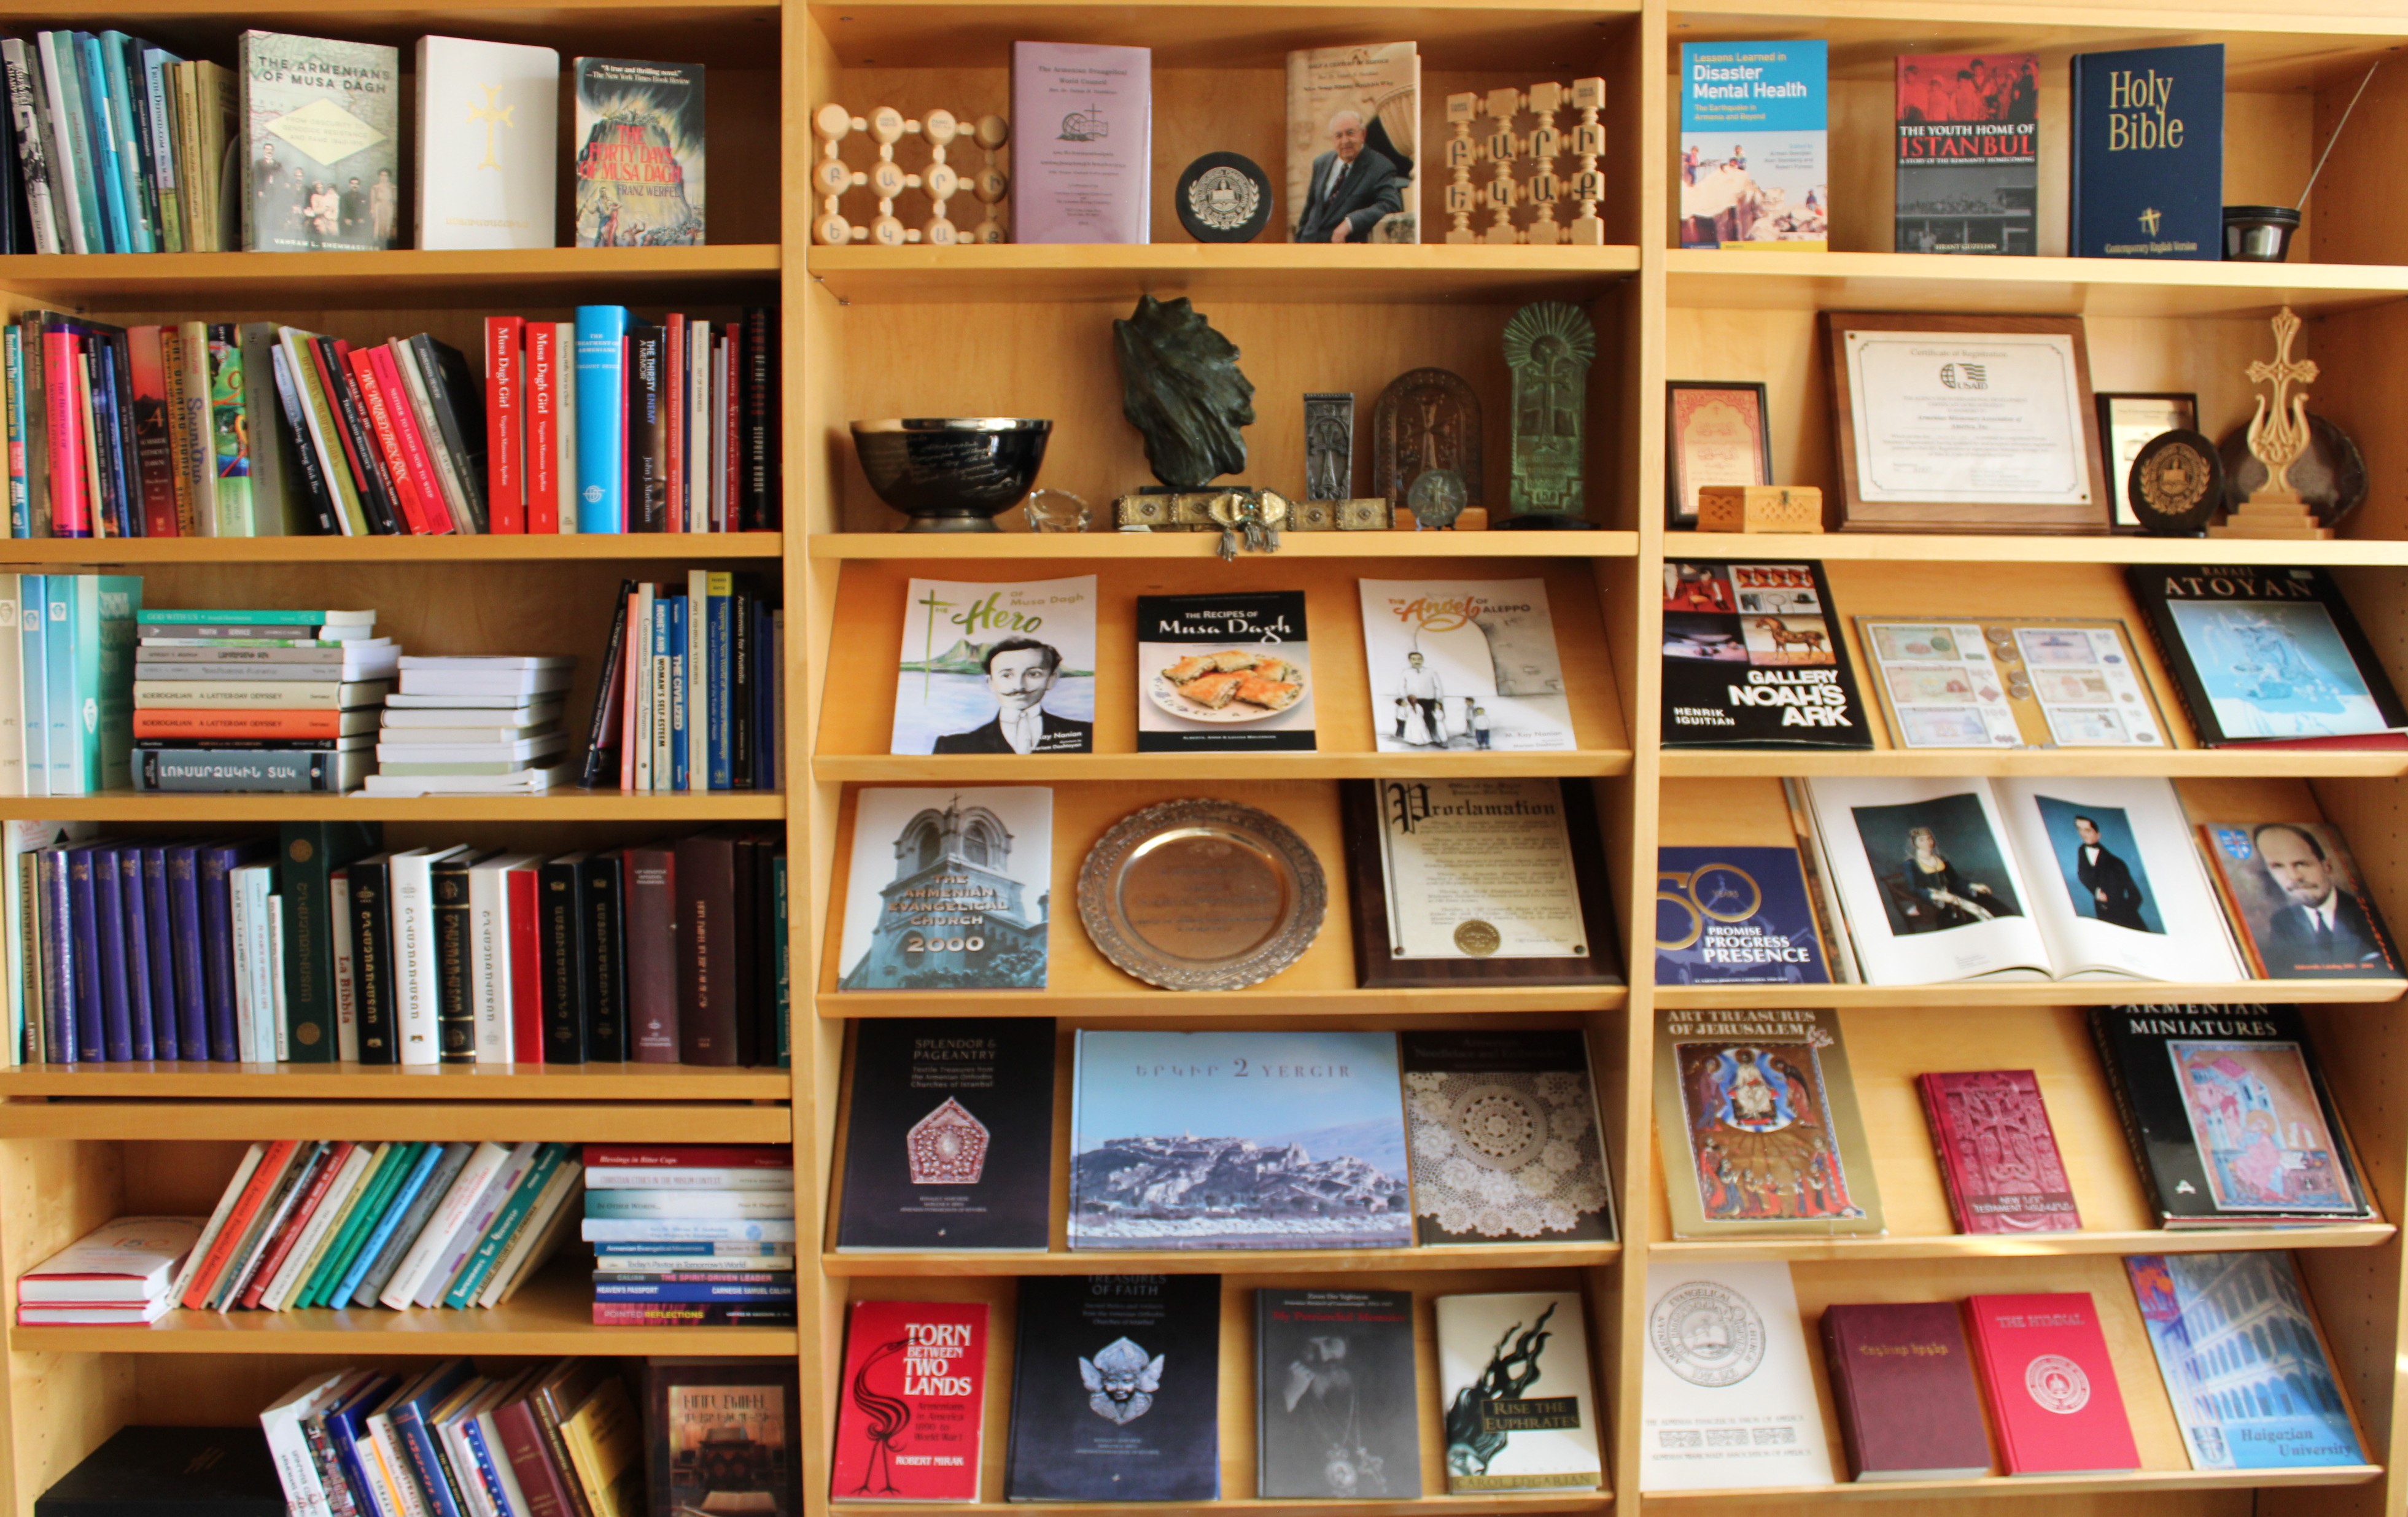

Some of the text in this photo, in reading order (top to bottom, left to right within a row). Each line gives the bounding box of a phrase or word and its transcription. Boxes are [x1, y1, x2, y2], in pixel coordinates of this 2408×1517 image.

[1694, 53, 1733, 62] Lessons
[1736, 52, 1775, 61] Learned
[258, 56, 390, 80] THE ARMENIANS
[1693, 64, 1763, 80] Disaster
[264, 71, 386, 93] OF MUSA DAGH
[1693, 81, 1807, 99] Mental Health
[2108, 69, 2174, 117] Holy
[1709, 104, 1749, 112] Earthquake
[1741, 112, 1766, 121] Beyond
[616, 125, 645, 144] THE
[1900, 123, 2035, 137] THE YOUTH HOME OF
[2108, 105, 2183, 151] Bible
[589, 142, 674, 164] FORTY DAYS
[1900, 135, 2035, 157] ISTANBUL
[579, 160, 682, 183] OF MUSA DAGH
[616, 185, 680, 198] FRANZ WERFEL
[2104, 241, 2197, 254] Contemporary English Version
[419, 348, 441, 400] ARMENIAN REVIEW
[496, 327, 509, 408] Musa Dagh Girl
[534, 333, 548, 414] Musa Dagh Girl
[647, 340, 656, 425] THE THIRSTY ENEMY
[389, 388, 435, 499] NEITHER TO LAUGH NOR TO WEEP
[643, 457, 652, 475] John
[2165, 576, 2313, 597] ATOYAN
[1050, 594, 1084, 605] Dagh
[952, 592, 1042, 635] Hero
[1393, 597, 1480, 623] Angel
[1483, 604, 1531, 613] ALEPPO
[656, 605, 665, 652] MONEY AND
[1160, 615, 1292, 645] Musa Dagh
[1748, 670, 1838, 685] GALLERY
[673, 655, 683, 731] THE CIVILIZED
[1728, 683, 1846, 706] NOAH'S
[1674, 707, 1724, 716] HENRIK
[1782, 706, 1853, 726] ARK
[1676, 716, 1735, 726] IGUITIAN
[268, 766, 296, 778] ՏԱԿ
[1388, 782, 1556, 834] Proclamation
[934, 875, 968, 884] THE
[905, 888, 993, 898] ARMENIAN
[888, 902, 1009, 912] EVANGELICAL
[911, 916, 983, 925] CHURCH
[1707, 926, 1762, 936] PROMISE
[907, 937, 985, 952] 2000
[1705, 936, 1790, 948] PROGRESS
[1703, 949, 1811, 963] PRESENCE
[339, 956, 354, 1024] La Bibbia
[1668, 1011, 1816, 1022] ART TREASURES
[2126, 1004, 2269, 1014] ARMENIAN
[1669, 1023, 1804, 1035] OF JERUSALEM
[2130, 1019, 2277, 1036] MINIATURES
[914, 1050, 996, 1060] PAGEANTRY
[1233, 1058, 1248, 1077] 2
[1262, 1065, 1350, 1078] YERGIR
[1973, 1203, 2022, 1212] TESTAMENT
[1092, 1285, 1159, 1295] OF FAITH
[1995, 1314, 2085, 1328] THE HYMNAL
[905, 1324, 972, 1346] TORN
[907, 1347, 963, 1357] BETWEEN
[903, 1358, 949, 1376] TWO
[904, 1377, 972, 1395] LANDS
[1494, 1402, 1566, 1415] RISE THE
[1485, 1417, 1579, 1430] EUPHRATES
[2240, 1428, 2314, 1443] Haigazian
[2278, 1443, 2352, 1457] University
[896, 1456, 964, 1465] ROBERT MIRAK
[1457, 1475, 1591, 1489] CAROL EDGARIAN
